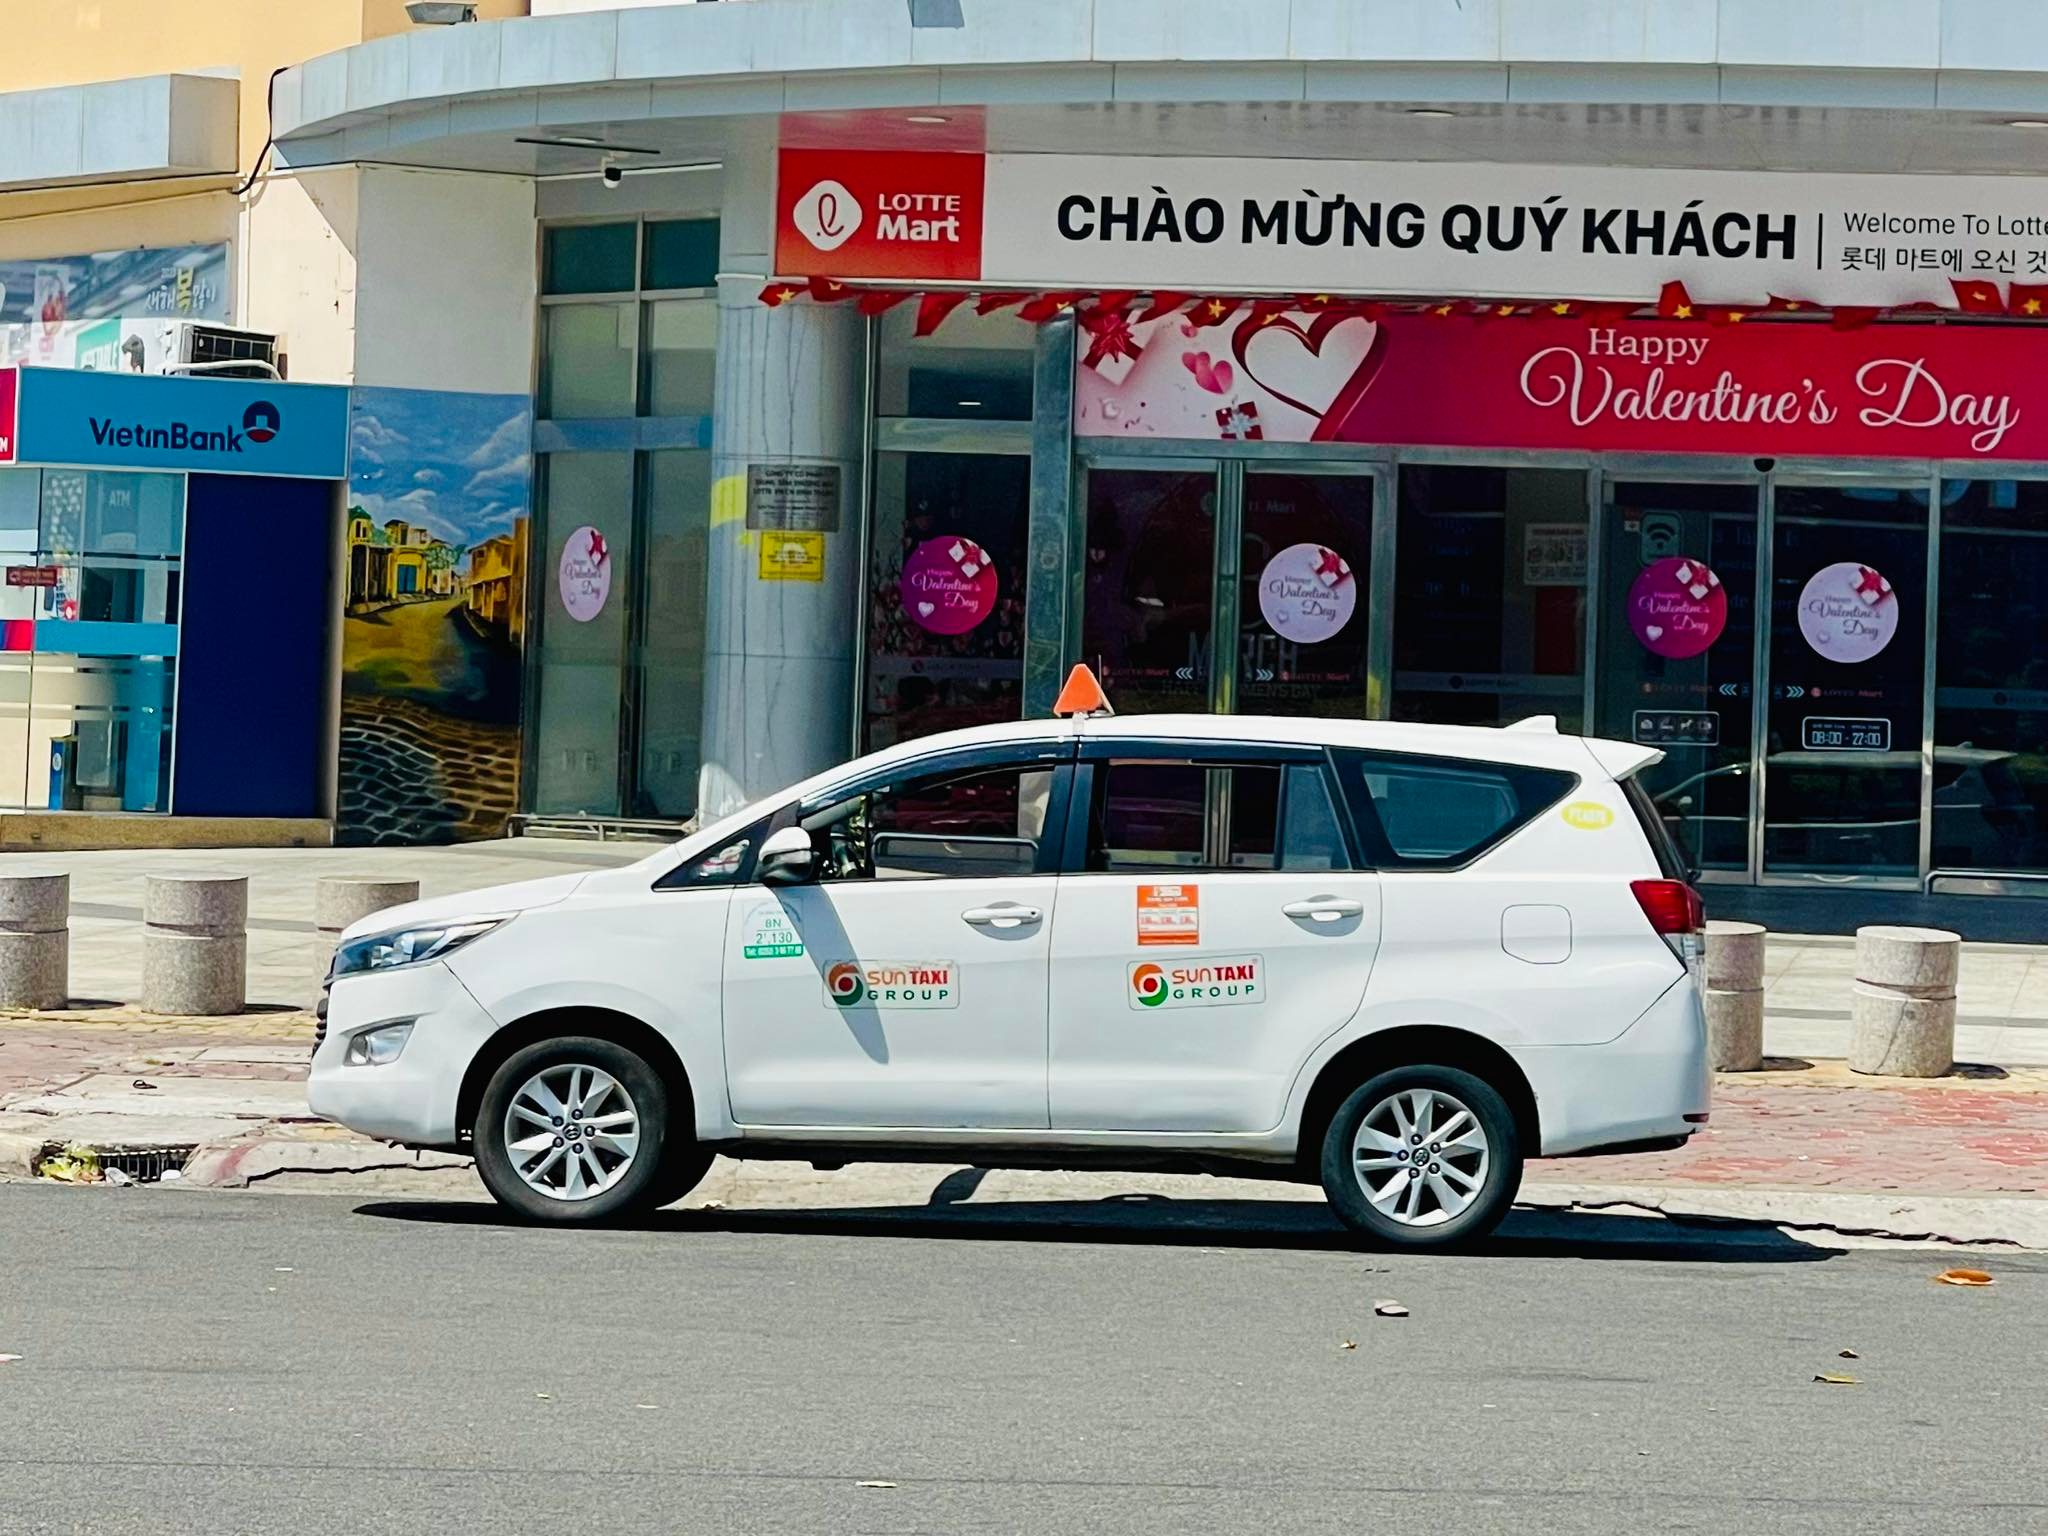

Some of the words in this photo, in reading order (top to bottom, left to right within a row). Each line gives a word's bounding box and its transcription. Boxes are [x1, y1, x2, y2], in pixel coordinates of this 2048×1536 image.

[878, 193, 961, 212] LOTTE
[876, 213, 960, 243] Mart
[1057, 185, 1225, 244] CHÀO
[1241, 188, 1426, 249] MỪNG
[1441, 195, 1569, 254] QUÝ
[1582, 199, 1797, 260] KHÁCH
[1843, 212, 1956, 235] Welcome
[1962, 214, 1990, 236] To
[1841, 246, 1886, 271] 롯데
[1896, 248, 1963, 273] 마트에
[1971, 249, 2016, 274] 오신
[1588, 328, 1710, 366] Happy
[1520, 346, 1839, 427] Valentine's
[1855, 358, 2021, 453] Day
[88, 416, 244, 453] VietinBank
[108, 489, 132, 508] ATM
[911, 572, 982, 592] Valentine's
[1269, 579, 1340, 600] Valentine's
[944, 591, 979, 613] Day
[1301, 600, 1337, 621] Day
[1672, 614, 1709, 636] Day
[1842, 619, 1879, 640] Day
[1811, 730, 1843, 745] 08:00
[909, 969, 949, 985] TAXI
[1213, 964, 1254, 981] TAXI
[867, 989, 949, 1001] GROUP
[1172, 984, 1255, 1000] GROUP
